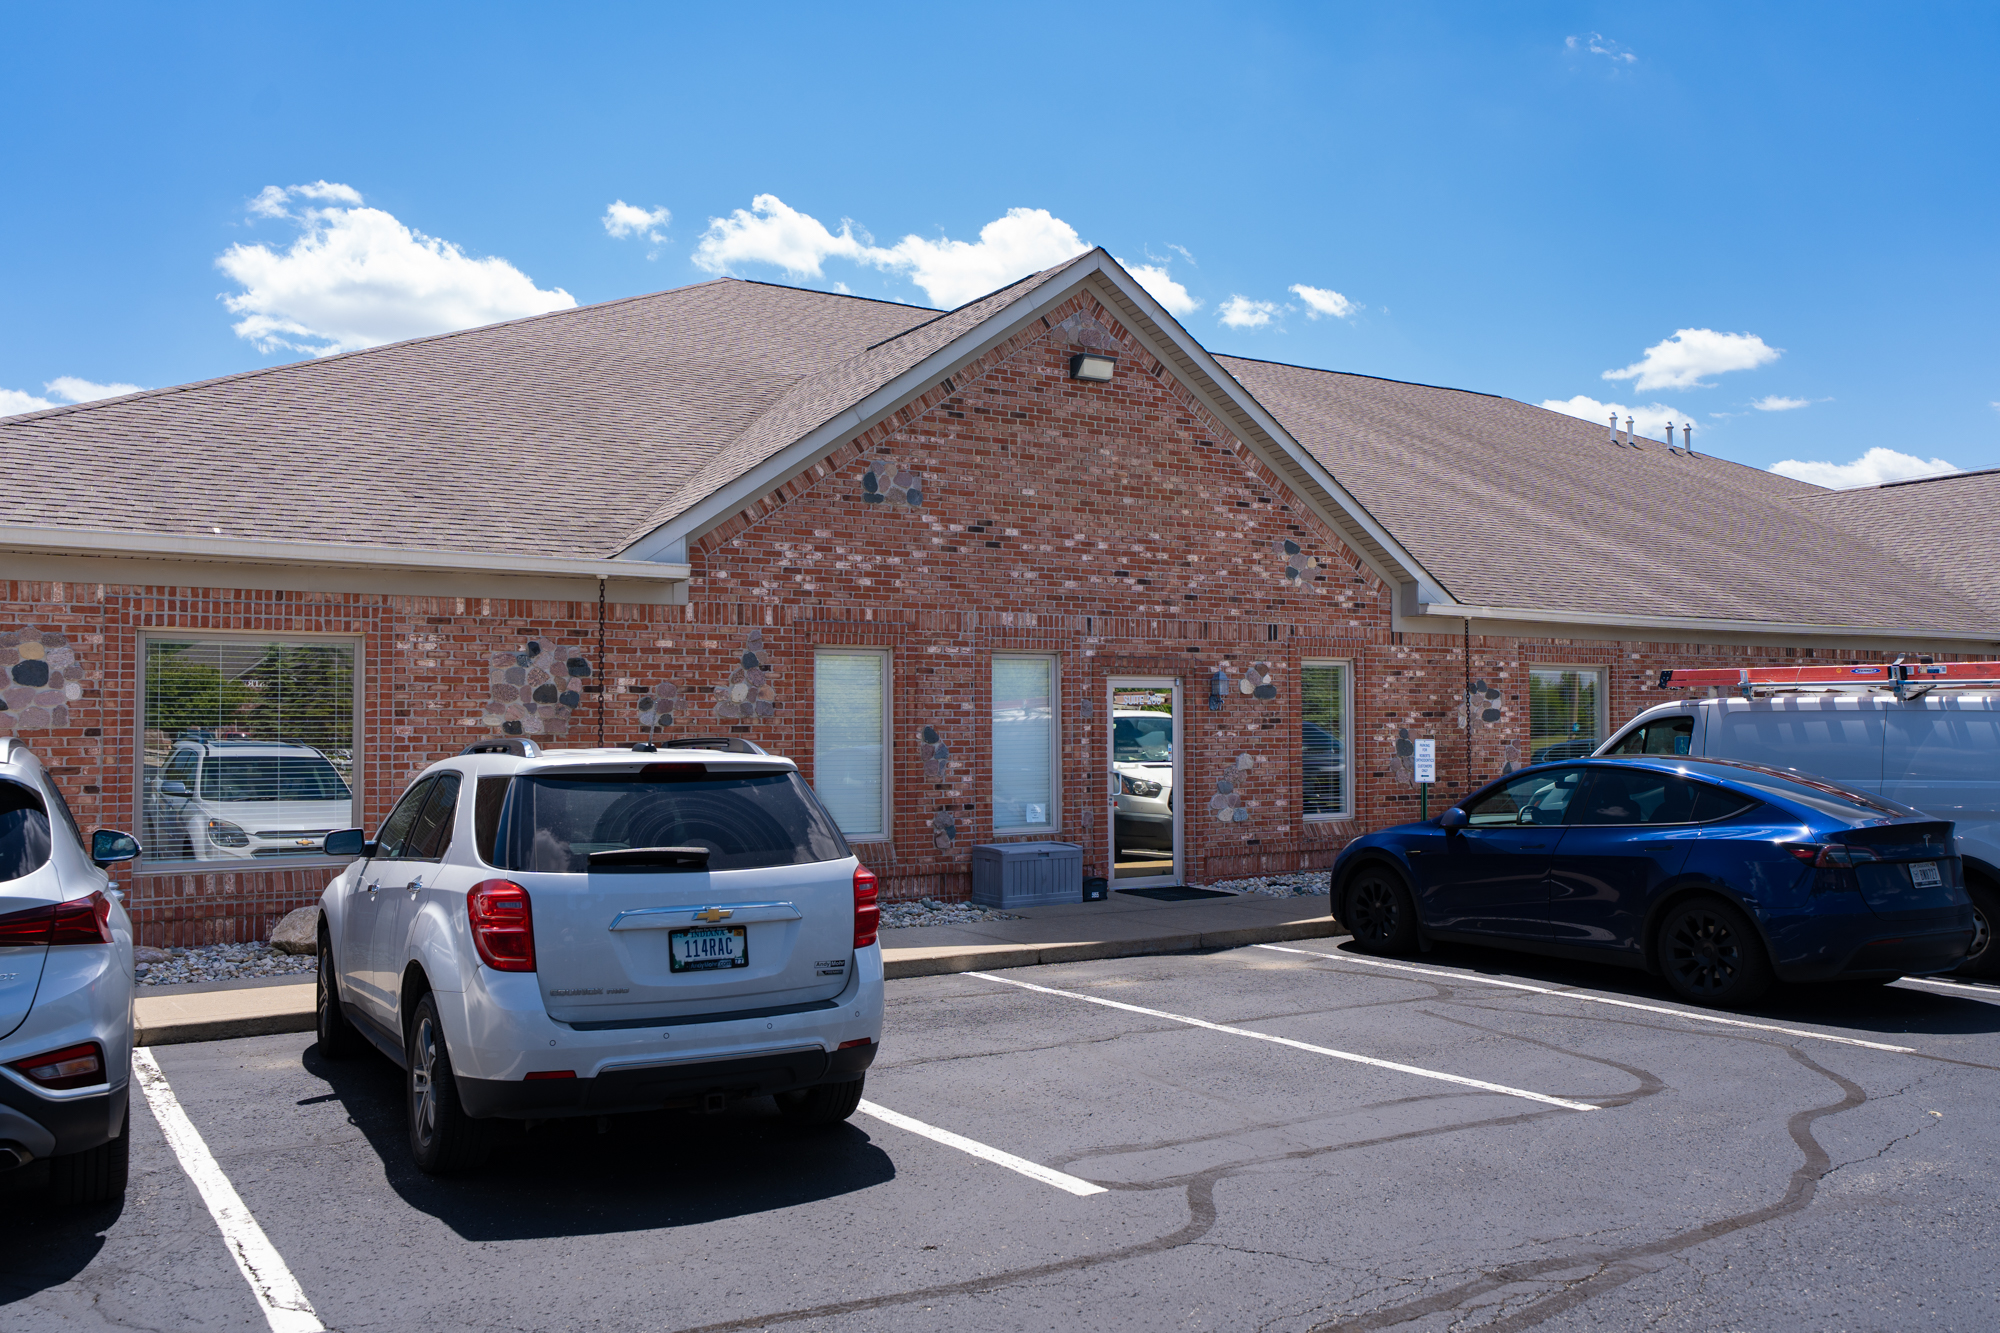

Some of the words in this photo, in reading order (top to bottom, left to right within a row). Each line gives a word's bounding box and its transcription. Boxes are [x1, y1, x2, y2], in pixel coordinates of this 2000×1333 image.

[1123, 695, 1144, 705] SUITE
[1147, 695, 1161, 705] 200
[691, 930, 726, 938] INDIANA
[684, 936, 733, 958] 114RAC
[550, 987, 603, 996] EQUINOX
